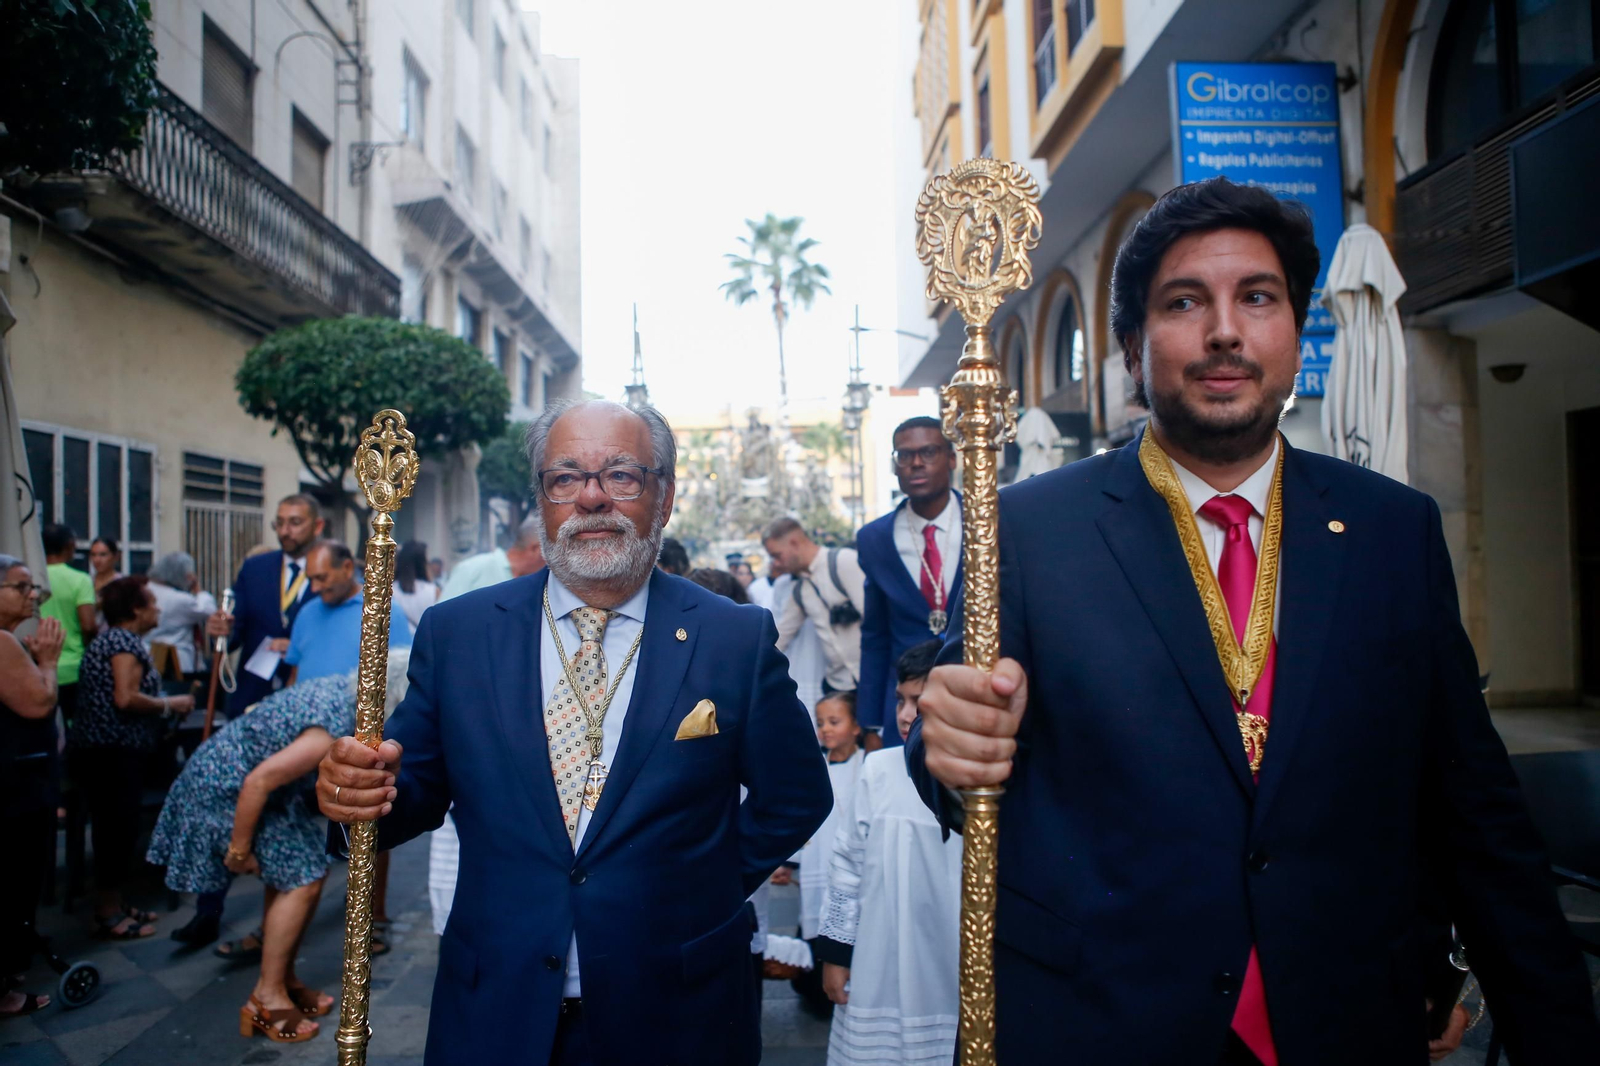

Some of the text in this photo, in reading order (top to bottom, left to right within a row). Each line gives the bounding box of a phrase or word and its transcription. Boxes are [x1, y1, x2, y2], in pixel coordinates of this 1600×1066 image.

[1186, 71, 1330, 105] Gibralcop
[1187, 107, 1330, 120] IMPRENTA DIGITAL
[1197, 130, 1252, 146] Imprenta
[1198, 152, 1323, 170] Regalos Publicitarios
